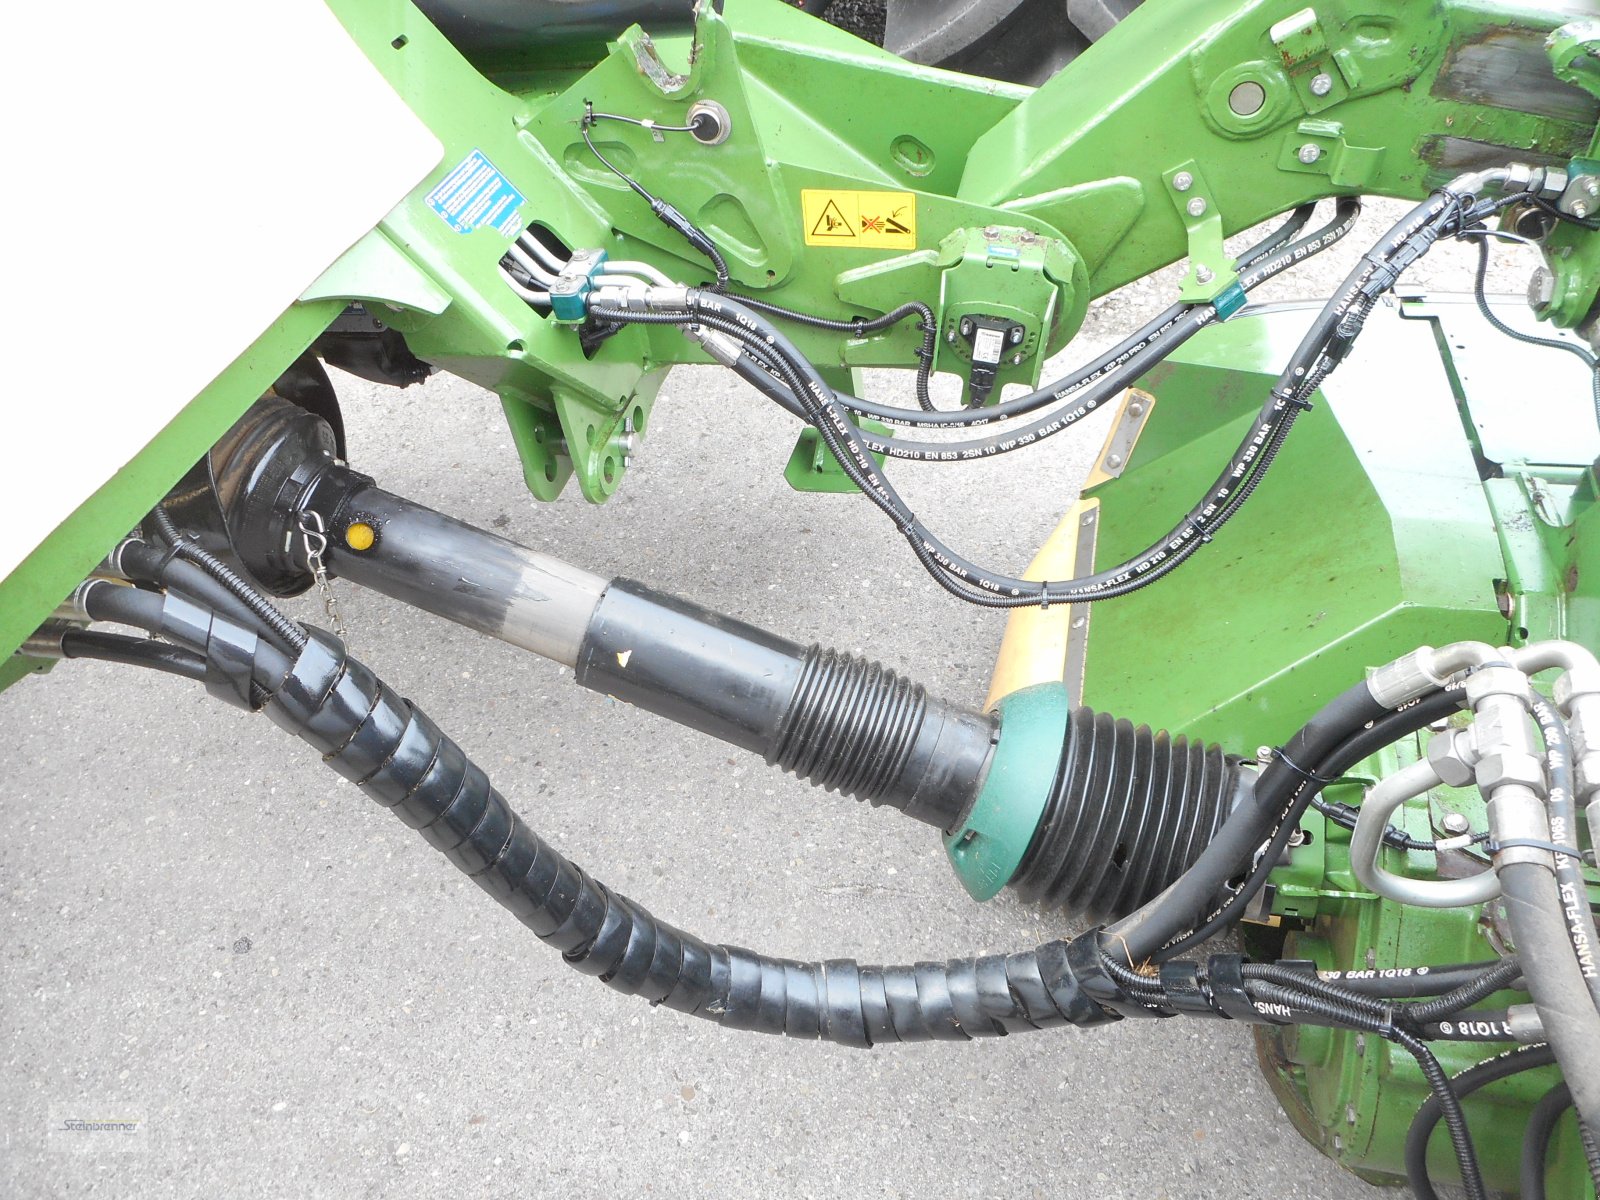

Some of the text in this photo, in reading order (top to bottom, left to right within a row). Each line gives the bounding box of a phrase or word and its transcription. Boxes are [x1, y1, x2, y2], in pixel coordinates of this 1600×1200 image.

[1390, 231, 1407, 248] HD
[1406, 215, 1424, 233] 210
[1263, 255, 1292, 276] HD210
[1294, 247, 1307, 259] EN
[1307, 238, 1322, 253] 853
[1322, 230, 1336, 244] 2SN
[700, 298, 722, 313] BAR
[735, 313, 758, 331] 1Q18
[1104, 360, 1118, 373] KP
[1115, 352, 1131, 366] 210
[1129, 341, 1147, 357] PRO
[1148, 330, 1162, 342] EN
[889, 446, 920, 460] HD210
[924, 450, 940, 461] EN
[940, 450, 958, 461] 853
[962, 448, 984, 460] 2SN
[984, 445, 997, 456] 10
[998, 438, 1017, 452] WP
[1017, 433, 1037, 447] 330
[1037, 421, 1061, 438] BAR
[1060, 405, 1088, 426] 1Q18
[847, 440, 858, 454] HD
[855, 456, 869, 469] 210
[867, 474, 880, 487] EN
[1135, 561, 1151, 573] HD
[1150, 551, 1167, 564] 210
[1168, 537, 1184, 550] EN
[1217, 487, 1230, 499] 10
[1231, 462, 1247, 478] WP
[1243, 445, 1258, 463] 330
[1253, 423, 1272, 445] BAR
[923, 540, 1000, 591] WP 330 BAR 1Q18
[1532, 701, 1556, 727] BAR
[1548, 749, 1565, 771] WP
[1550, 788, 1564, 803] 06
[1559, 881, 1598, 980] HANSA-FLEX
[1345, 968, 1375, 980] BAR
[1378, 966, 1412, 979] 1Q18
[1457, 1020, 1500, 1037] 1Q18
